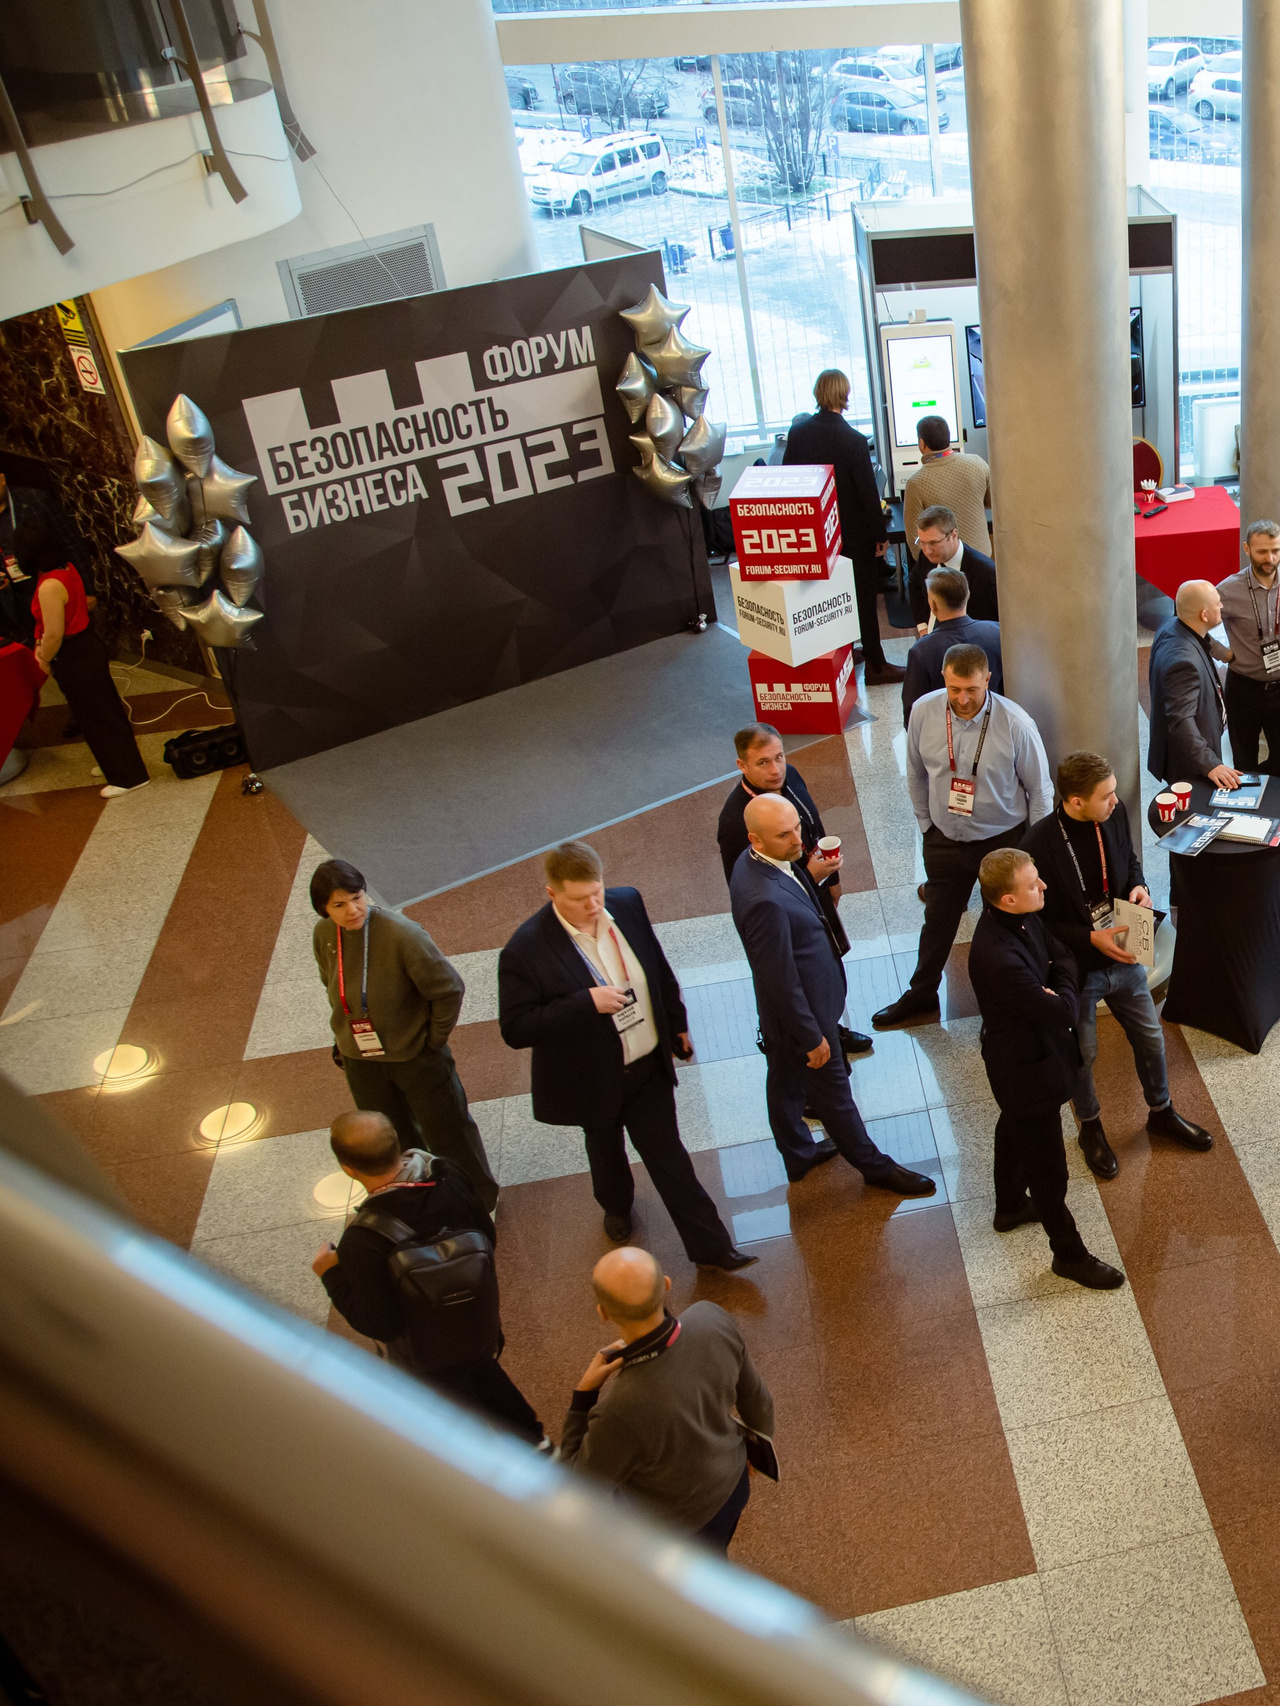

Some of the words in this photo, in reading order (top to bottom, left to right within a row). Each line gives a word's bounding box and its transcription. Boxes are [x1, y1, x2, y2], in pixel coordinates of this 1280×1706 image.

[482, 325, 596, 383] ФОРУМ
[267, 396, 509, 485] БЕЗОПАСНОСТЬ
[436, 416, 615, 517] 2023
[280, 464, 428, 534] БИЗНЕСА
[737, 503, 814, 516] БЕЗОПАСНОСТЬ
[741, 528, 818, 554] 2023
[746, 564, 822, 575] FORUM-SECURITY.RU
[737, 596, 785, 625] БЕЗОПАСНОСТЬ
[739, 609, 786, 636] FORUM-SECURITY.RU
[792, 592, 852, 625] БЕЗОПАСНОСТЬ
[794, 604, 853, 636] FORUM-SECURITY.RU
[760, 692, 812, 701] БЕЗОПАСНОСТЬ
[804, 683, 830, 692] ФОРУМ
[1190, 826, 1221, 848] 2023
